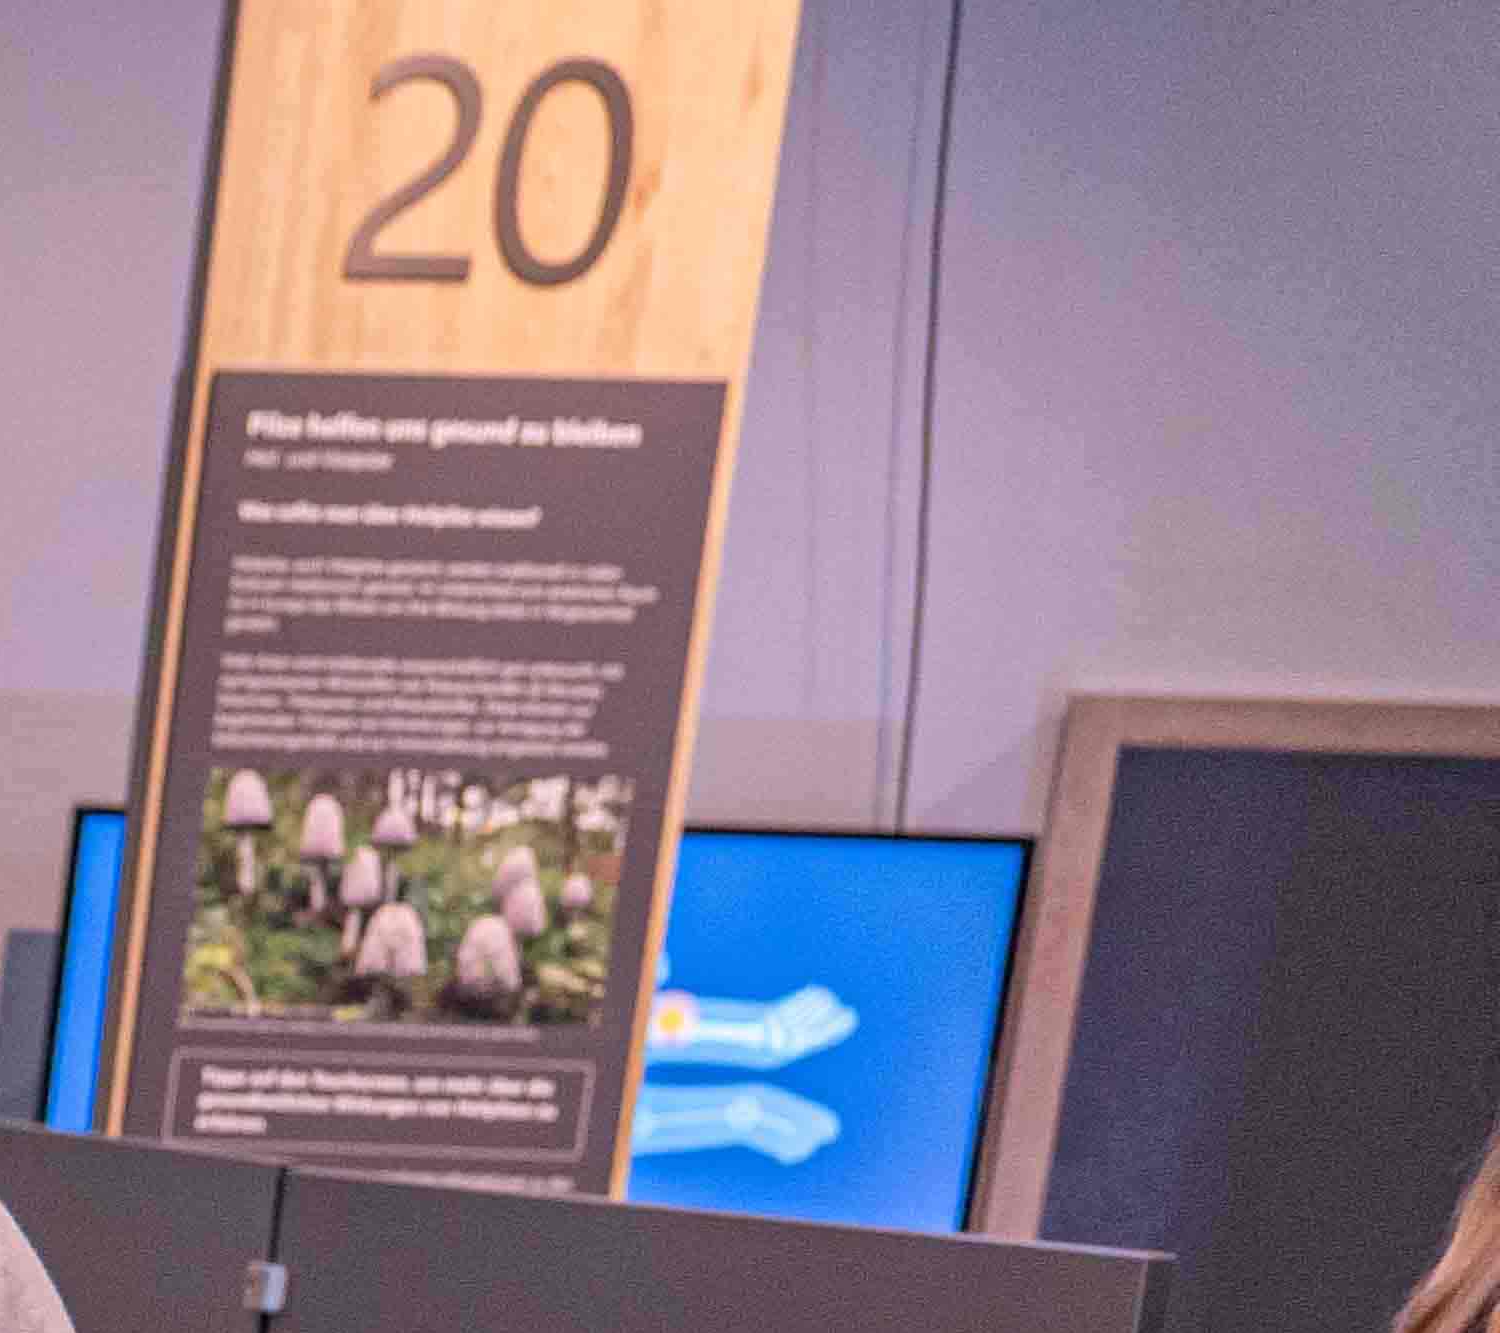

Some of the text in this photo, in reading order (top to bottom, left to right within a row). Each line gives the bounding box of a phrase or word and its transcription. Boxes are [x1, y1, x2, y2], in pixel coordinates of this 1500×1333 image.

[343, 54, 636, 290] 20
[246, 409, 303, 440] Pilze
[304, 409, 382, 442] helfen
[429, 414, 519, 450] gesund
[551, 416, 643, 448] bleiben
